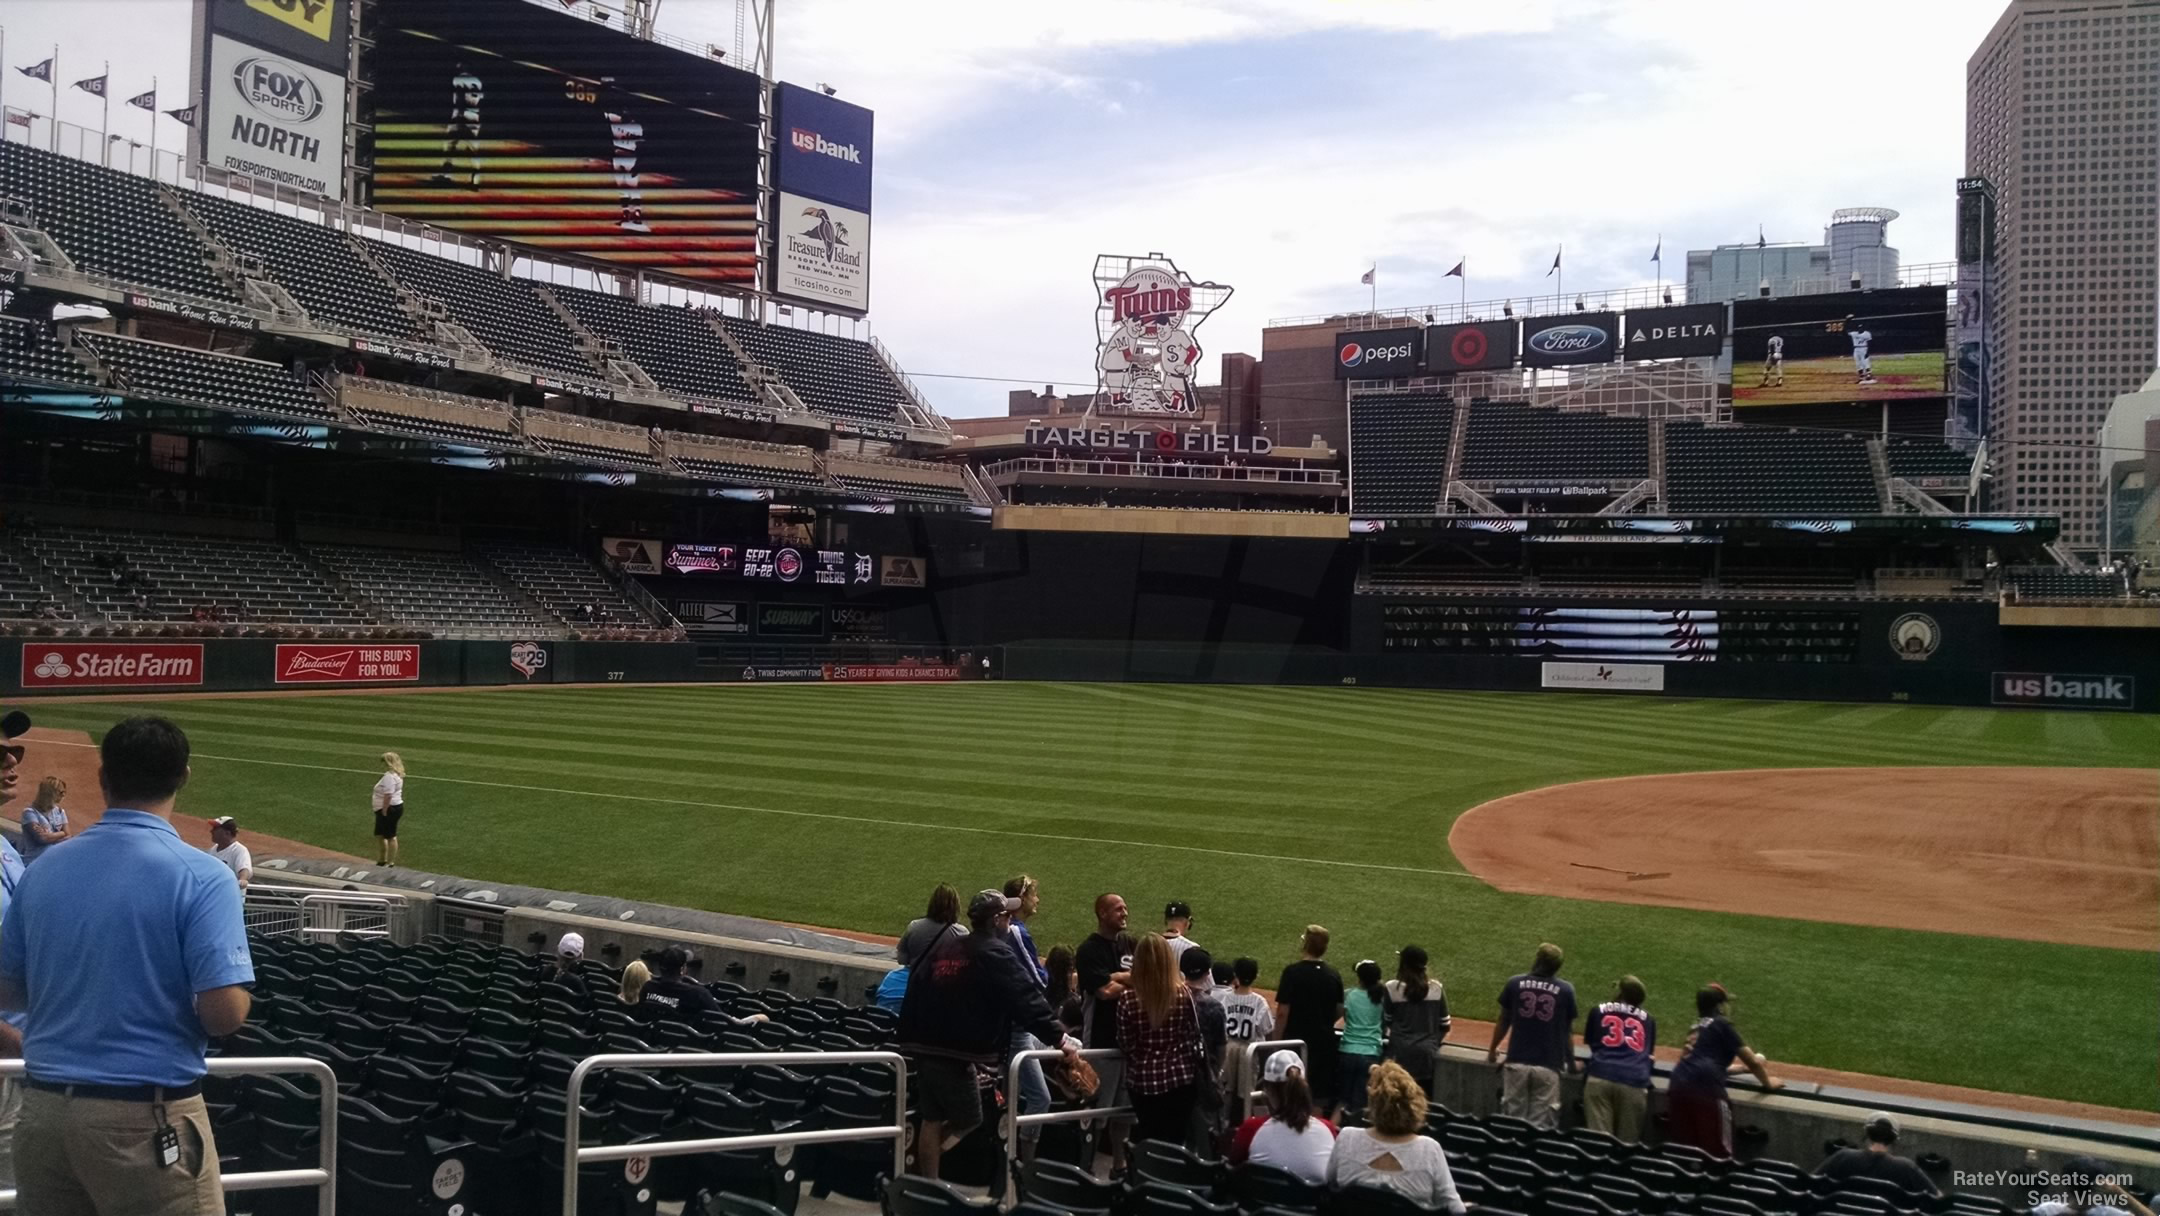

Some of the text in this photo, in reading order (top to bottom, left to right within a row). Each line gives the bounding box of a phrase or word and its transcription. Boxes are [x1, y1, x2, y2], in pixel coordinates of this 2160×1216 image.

[83, 80, 102, 91] 06
[253, 64, 305, 105] FOX
[136, 95, 154, 107] 09
[252, 91, 306, 116] SPORTS
[179, 110, 193, 121] 10
[231, 114, 320, 163] NORTH
[224, 155, 326, 193] FOXSPORTSNORTH.COM
[1957, 179, 1983, 190] 11:54
[787, 235, 860, 267] Treasure Island
[788, 255, 818, 265] RESORT
[830, 264, 860, 275] CASINO
[0, 271, 17, 284] rch
[794, 277, 852, 297] ticasino.com
[1105, 283, 1192, 325] Twins
[180, 304, 207, 321] Home
[208, 312, 227, 325] Run
[229, 316, 254, 330] Porch
[1544, 329, 1591, 351] Ford
[1652, 324, 1717, 340] DELTA
[393, 348, 413, 361] Home
[415, 353, 429, 364] Run
[430, 355, 451, 368] Porch
[1365, 342, 1412, 364] pepsi
[565, 383, 582, 394] Home
[583, 386, 595, 397] Run
[594, 389, 611, 400] Porch
[722, 409, 741, 418] Home
[742, 412, 756, 421] Run
[756, 413, 772, 423] Porch
[1024, 426, 1273, 454] TARGET FIELD
[1572, 486, 1608, 496] Ballpark
[668, 552, 720, 570] Summer
[745, 549, 771, 563] SEPT.
[818, 551, 844, 565] TWINS
[743, 564, 773, 578] 20-22
[815, 571, 845, 584] TIGERS
[762, 609, 818, 625] SUBWAY
[291, 656, 347, 669] Budweiser
[358, 650, 412, 662] THIS BUD'S
[526, 651, 545, 666] 29
[358, 664, 402, 676] FOR YOU.
[608, 672, 624, 681] 377
[758, 669, 822, 677] TWINS COMMUNITY FUND
[834, 667, 847, 679] 25
[848, 668, 866, 678] YEARS
[868, 668, 875, 678] OF
[876, 668, 894, 678] GIVING
[895, 668, 909, 678] KIDS
[915, 668, 936, 678] CHANCE
[937, 668, 944, 678] TO
[1519, 980, 1560, 994] MORNEAU
[1519, 991, 1555, 1022] 33
[1599, 1002, 1648, 1020] MORNEAU
[1226, 1017, 1252, 1040] 20
[1601, 1015, 1646, 1052] 33
